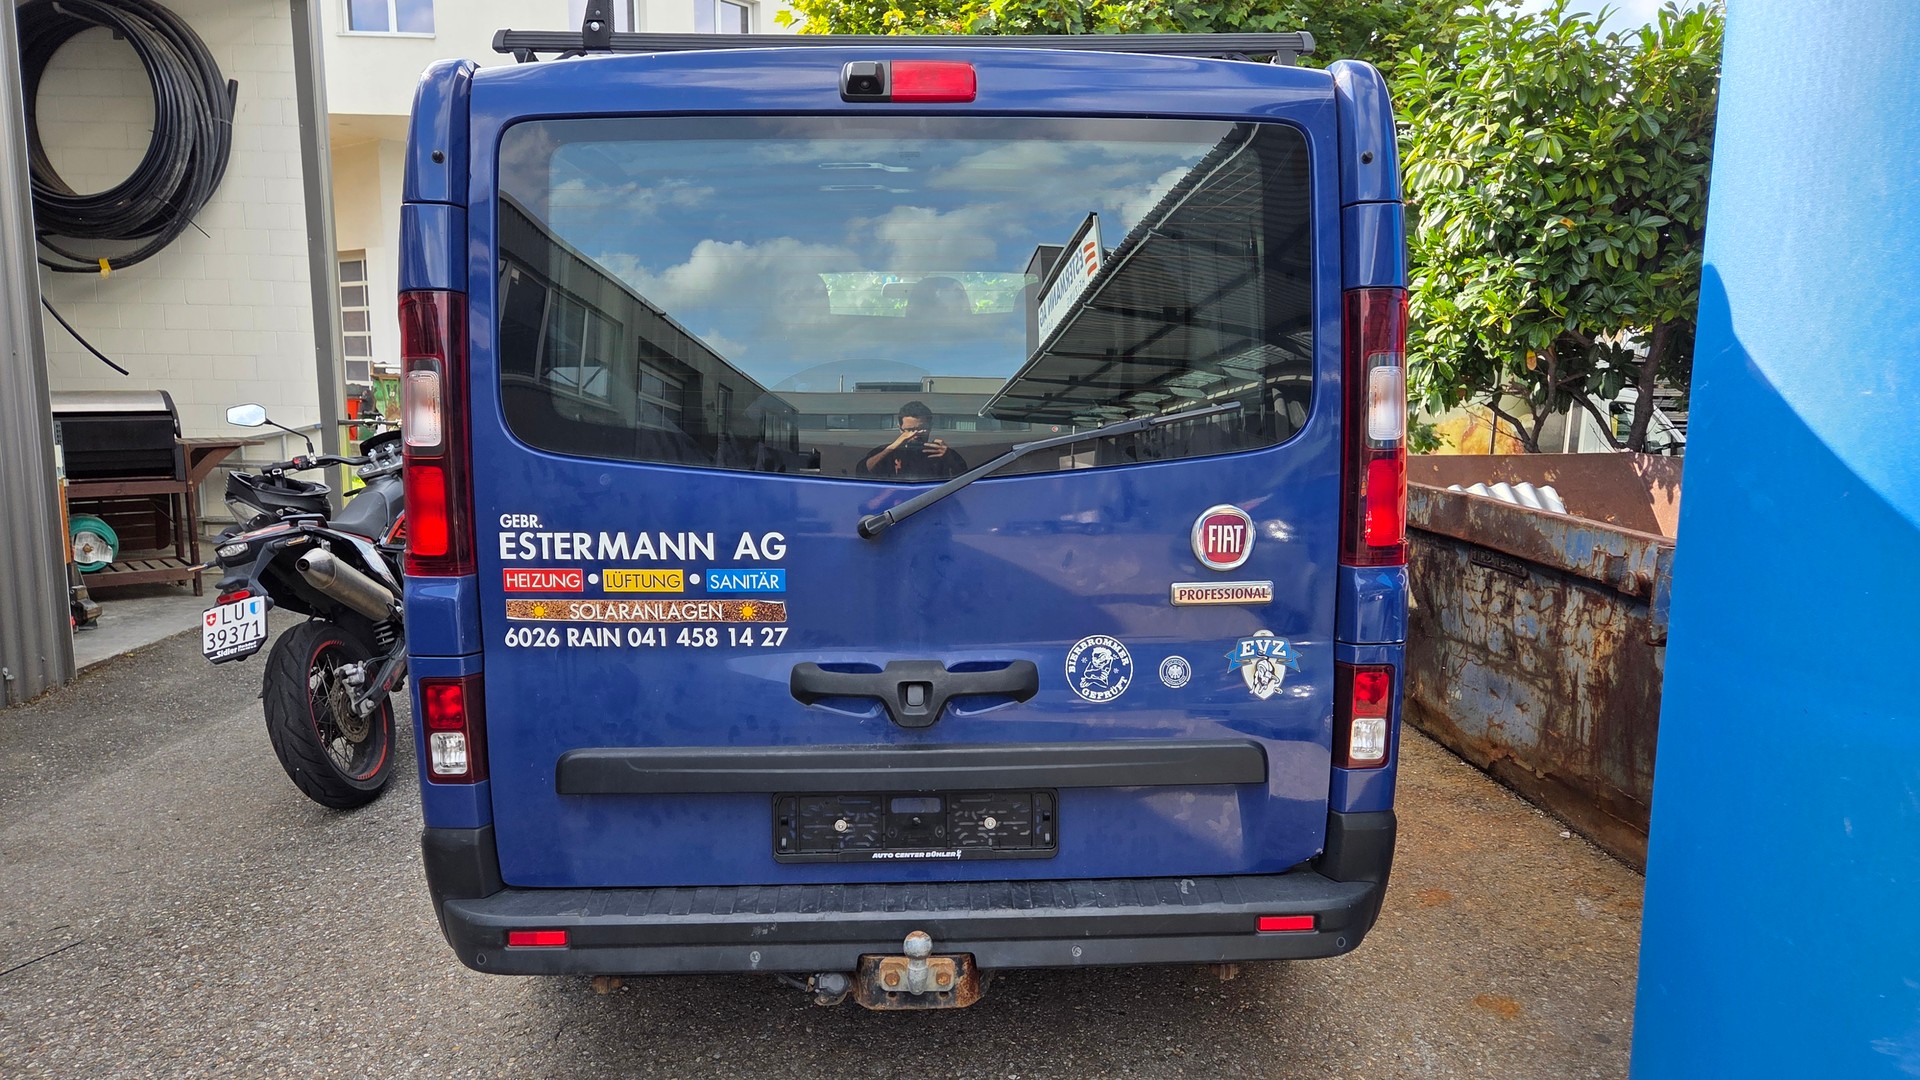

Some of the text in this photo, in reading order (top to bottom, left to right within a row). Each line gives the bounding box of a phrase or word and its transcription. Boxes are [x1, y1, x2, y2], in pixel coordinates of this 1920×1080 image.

[500, 513, 543, 528] GEBR.
[499, 531, 787, 560] ESTERMANN AG
[1208, 524, 1244, 553] FIAT
[505, 571, 780, 589] HEIZUNG LÜFTUNG SANITÄR
[1179, 587, 1268, 601] PROFESSIONAL
[222, 602, 245, 625] LU
[569, 603, 723, 620] SOLARANLAGEN
[206, 620, 260, 651] 39371
[504, 627, 789, 647] 6026 RAIN 041 458 14 27
[1068, 637, 1129, 674] BIERBROMMER
[1240, 639, 1287, 657] EVZ
[1081, 675, 1128, 699] GEPRÜFT
